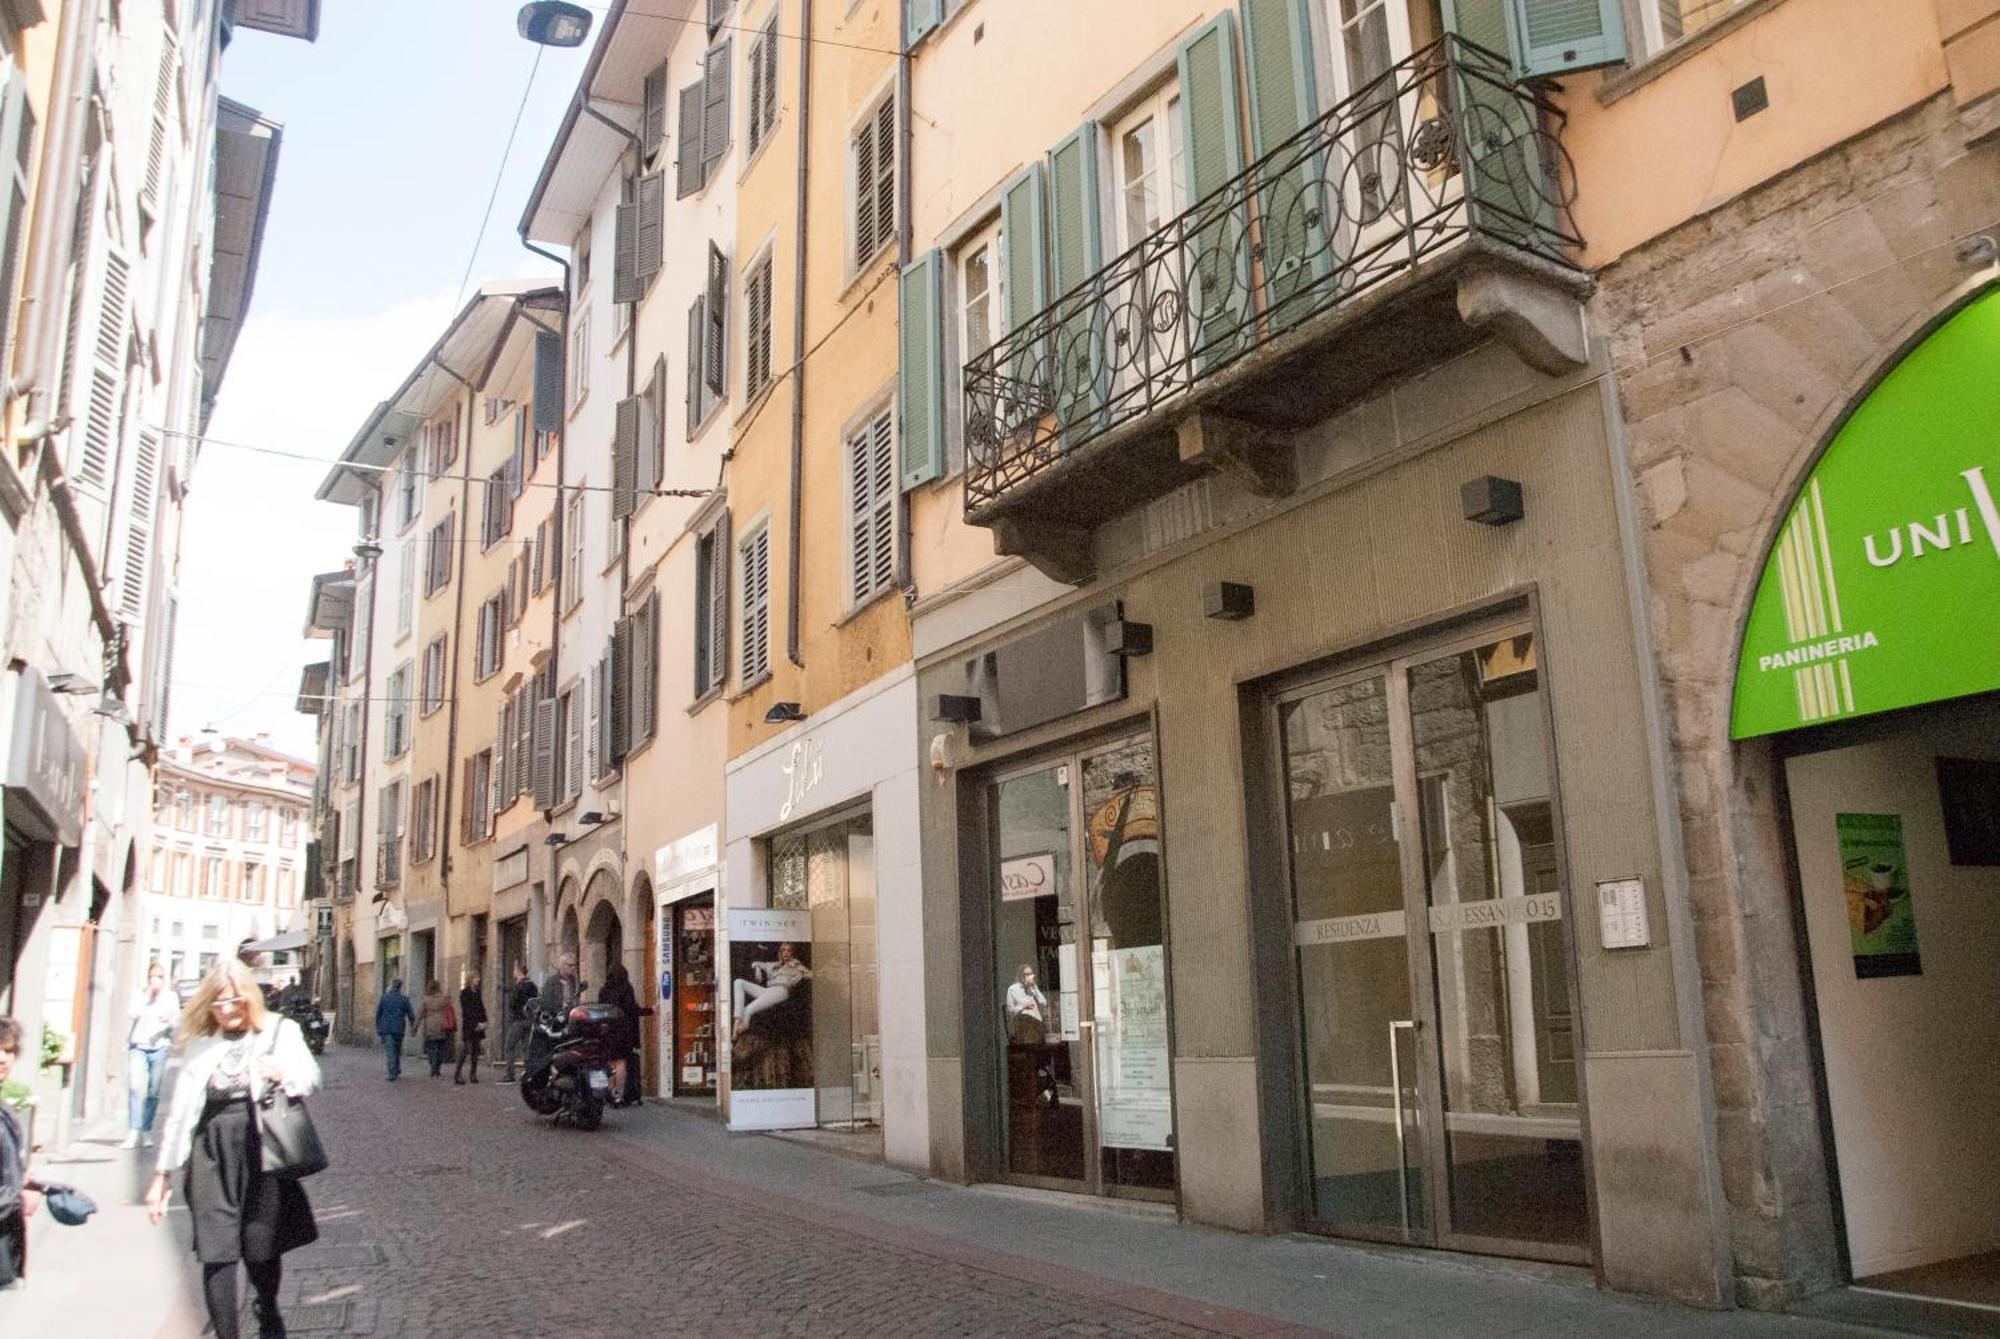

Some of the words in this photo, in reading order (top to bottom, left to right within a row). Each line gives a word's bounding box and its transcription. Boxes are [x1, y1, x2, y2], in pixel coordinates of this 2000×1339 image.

[1759, 631, 1879, 672] PANINERIA
[661, 916, 671, 964] SAMSUNG
[1315, 918, 1382, 940] RESIDENZA
[1543, 900, 1556, 918] 15
